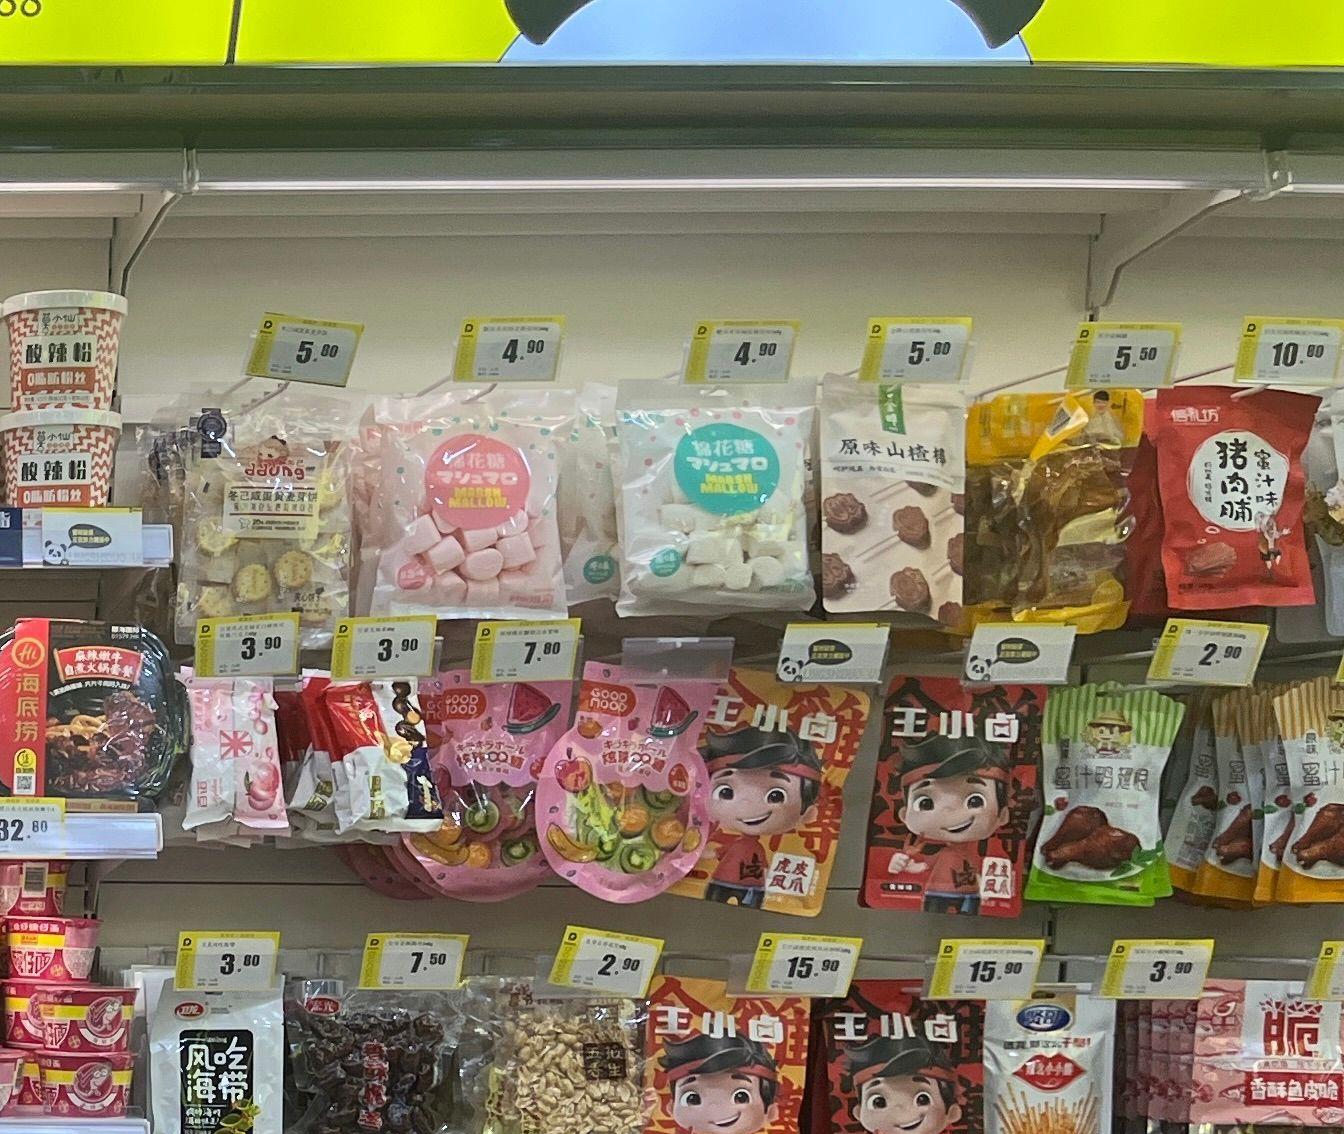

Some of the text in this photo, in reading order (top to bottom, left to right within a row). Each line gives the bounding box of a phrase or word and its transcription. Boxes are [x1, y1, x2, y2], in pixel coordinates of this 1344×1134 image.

[26, 342, 92, 363] 酸辣粉
[503, 339, 545, 364] 4.90
[1114, 346, 1157, 370] 5.50
[686, 456, 768, 472] マシュマロ
[839, 439, 946, 466] 原味山楂棒
[22, 460, 86, 481] 酸辣粉
[245, 464, 305, 480] ddung
[436, 471, 517, 485] マシュマロ
[1217, 440, 1253, 522] 猪肉脯
[1254, 450, 1278, 507] 蜜汁味
[378, 638, 418, 662] 3.90
[14, 672, 40, 743] 海底捞
[590, 688, 628, 702] GOOD
[706, 697, 838, 743] 王小卤
[892, 706, 1020, 743] 王小卤
[411, 952, 446, 974] 7.50
[969, 960, 1023, 982] 15.90
[657, 1004, 784, 1044] 王小卤
[834, 1011, 958, 1043] 王小卤
[187, 1038, 248, 1069] 风吃
[187, 1069, 248, 1103] 海带
